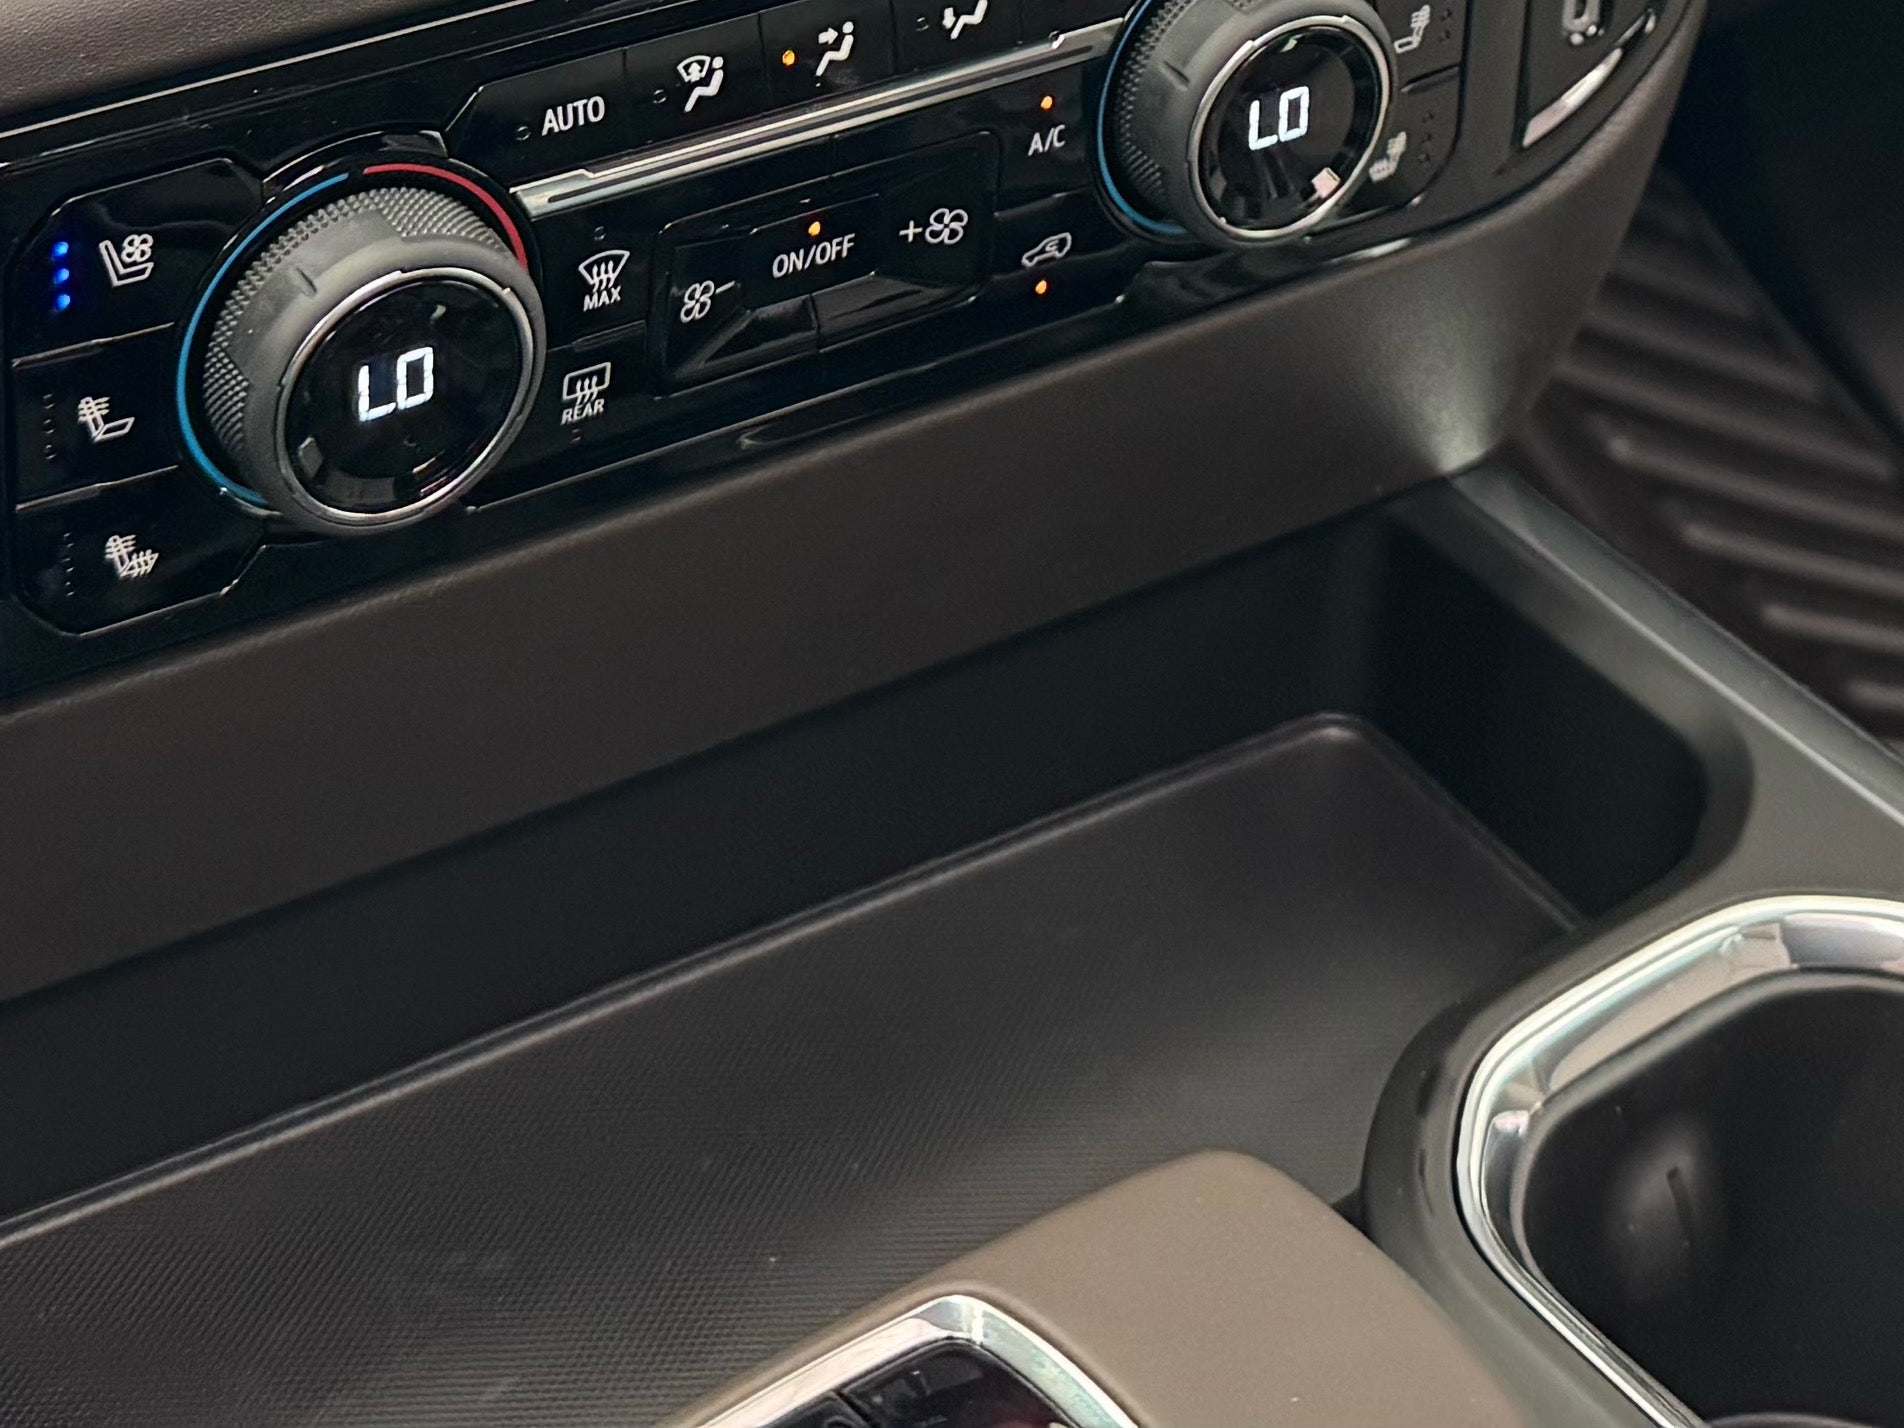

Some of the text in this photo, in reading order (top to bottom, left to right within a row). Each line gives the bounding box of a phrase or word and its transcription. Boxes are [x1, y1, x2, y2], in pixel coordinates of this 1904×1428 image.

[541, 96, 606, 136] AUTO
[1027, 125, 1066, 157] A/C
[772, 234, 855, 280] ON/OFF
[582, 285, 622, 311] MAX
[560, 398, 605, 425] REAR
